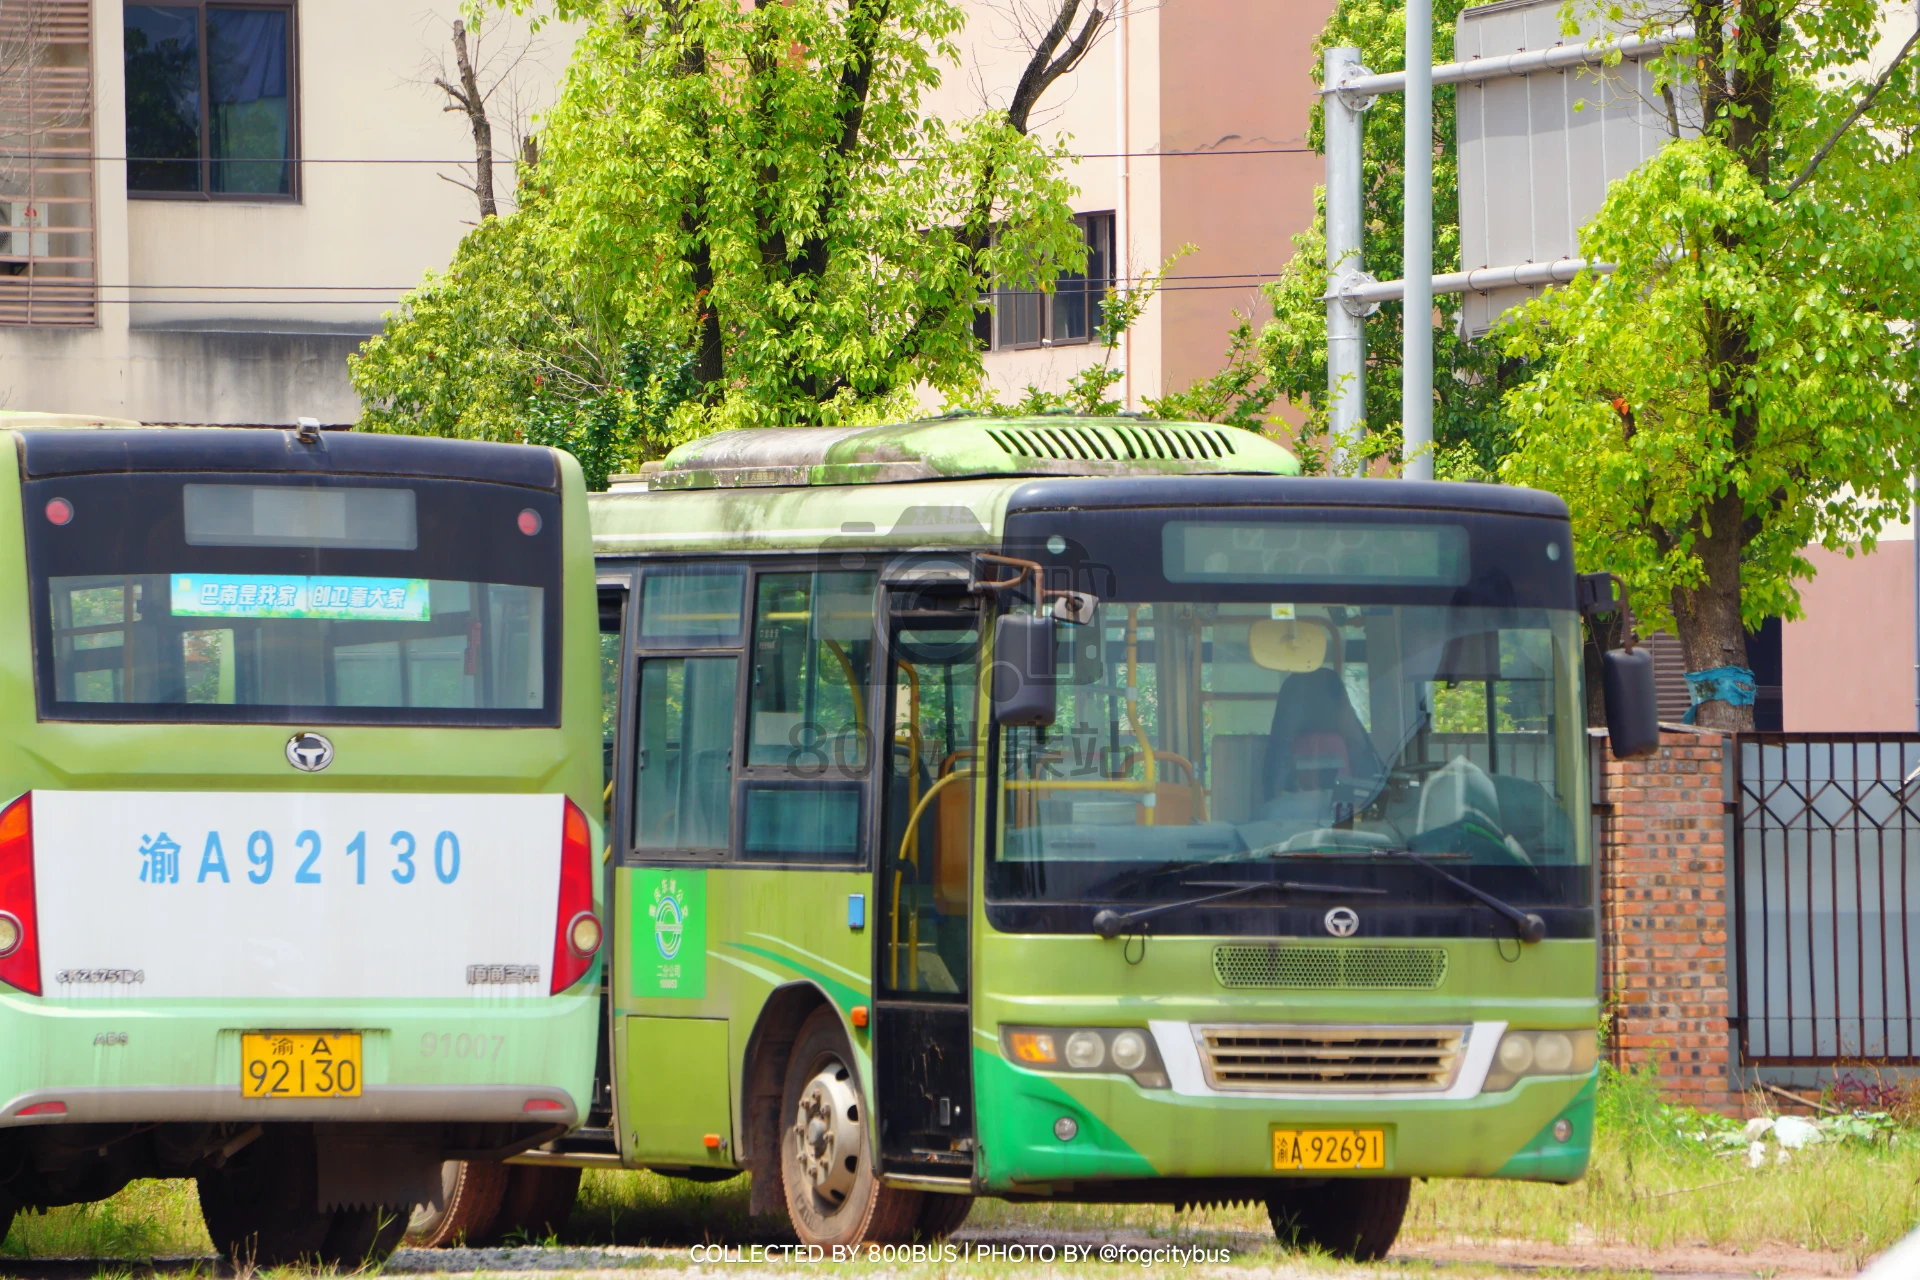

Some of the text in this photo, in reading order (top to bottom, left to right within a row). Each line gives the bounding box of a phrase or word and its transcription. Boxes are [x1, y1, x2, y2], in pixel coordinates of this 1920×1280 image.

[200, 583, 406, 609] 巴南是我家 创卫靠大家
[138, 829, 461, 885] 渝A92130
[466, 964, 540, 985] 恒通客车
[93, 1031, 129, 1047] ABS
[420, 1031, 505, 1063] 91007
[249, 1059, 356, 1093] 92130
